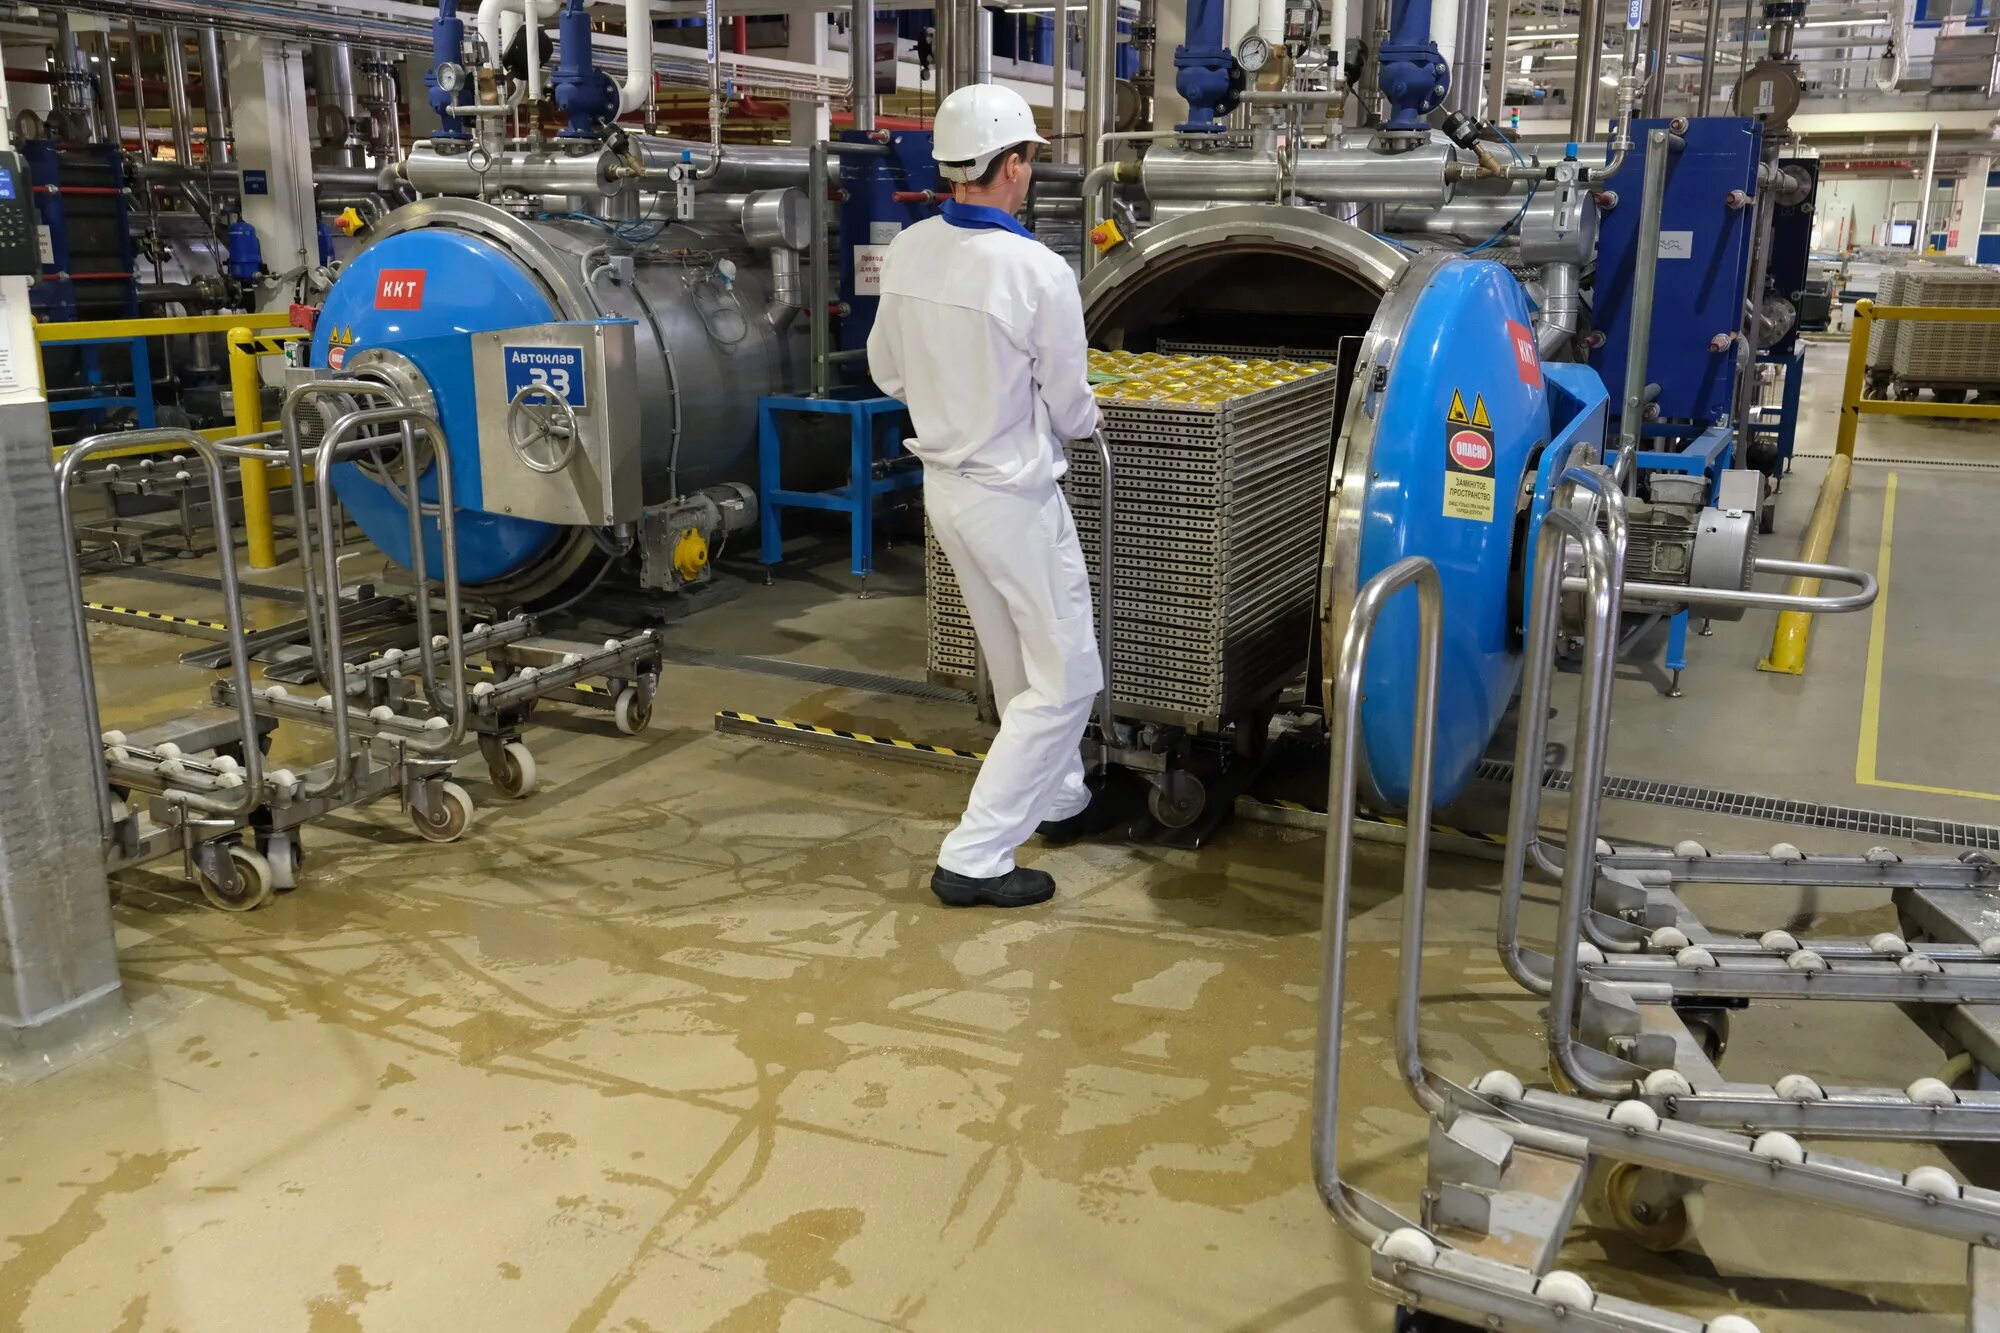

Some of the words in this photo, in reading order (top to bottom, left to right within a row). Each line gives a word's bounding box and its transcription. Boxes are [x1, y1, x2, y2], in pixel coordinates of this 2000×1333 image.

[512, 350, 575, 365] Автоклав
[529, 367, 571, 398] 33
[1456, 441, 1488, 461] ОПАСНО
[1455, 477, 1487, 490] ЗАМКНУТОЕ
[1449, 487, 1491, 501] ПРОСТРАНСТВО
